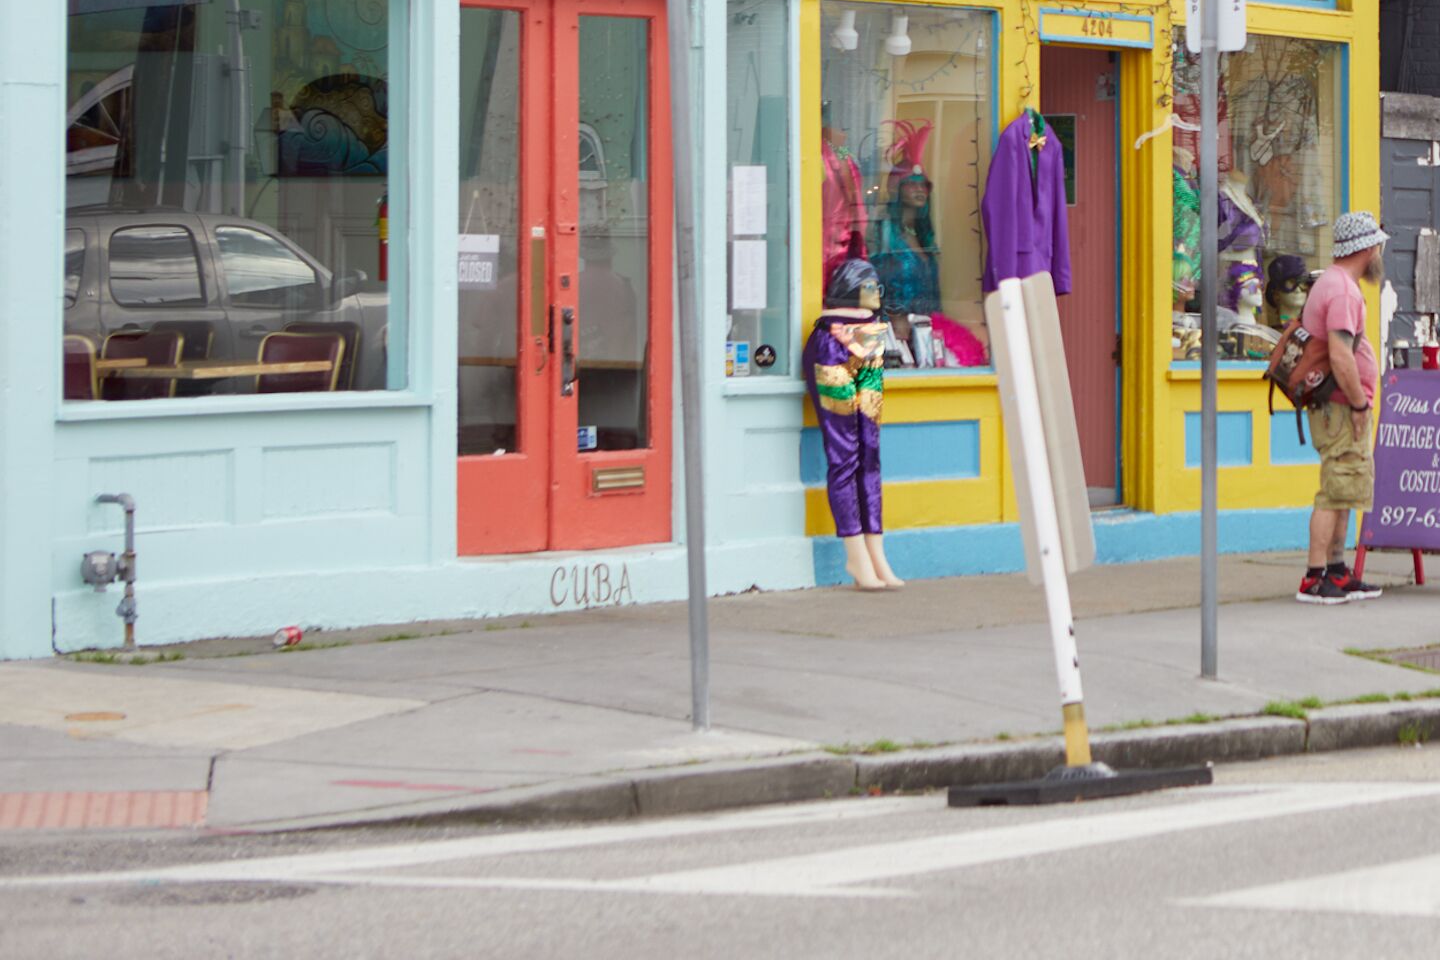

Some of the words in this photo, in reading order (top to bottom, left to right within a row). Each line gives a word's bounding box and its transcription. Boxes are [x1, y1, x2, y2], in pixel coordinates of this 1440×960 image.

[1081, 18, 1113, 38] 4204
[459, 261, 493, 283] CLOSED
[1386, 392, 1429, 417] Miss
[1378, 424, 1435, 450] VINTAGE
[1432, 453, 1440, 468] &
[549, 562, 633, 607] CUBA
